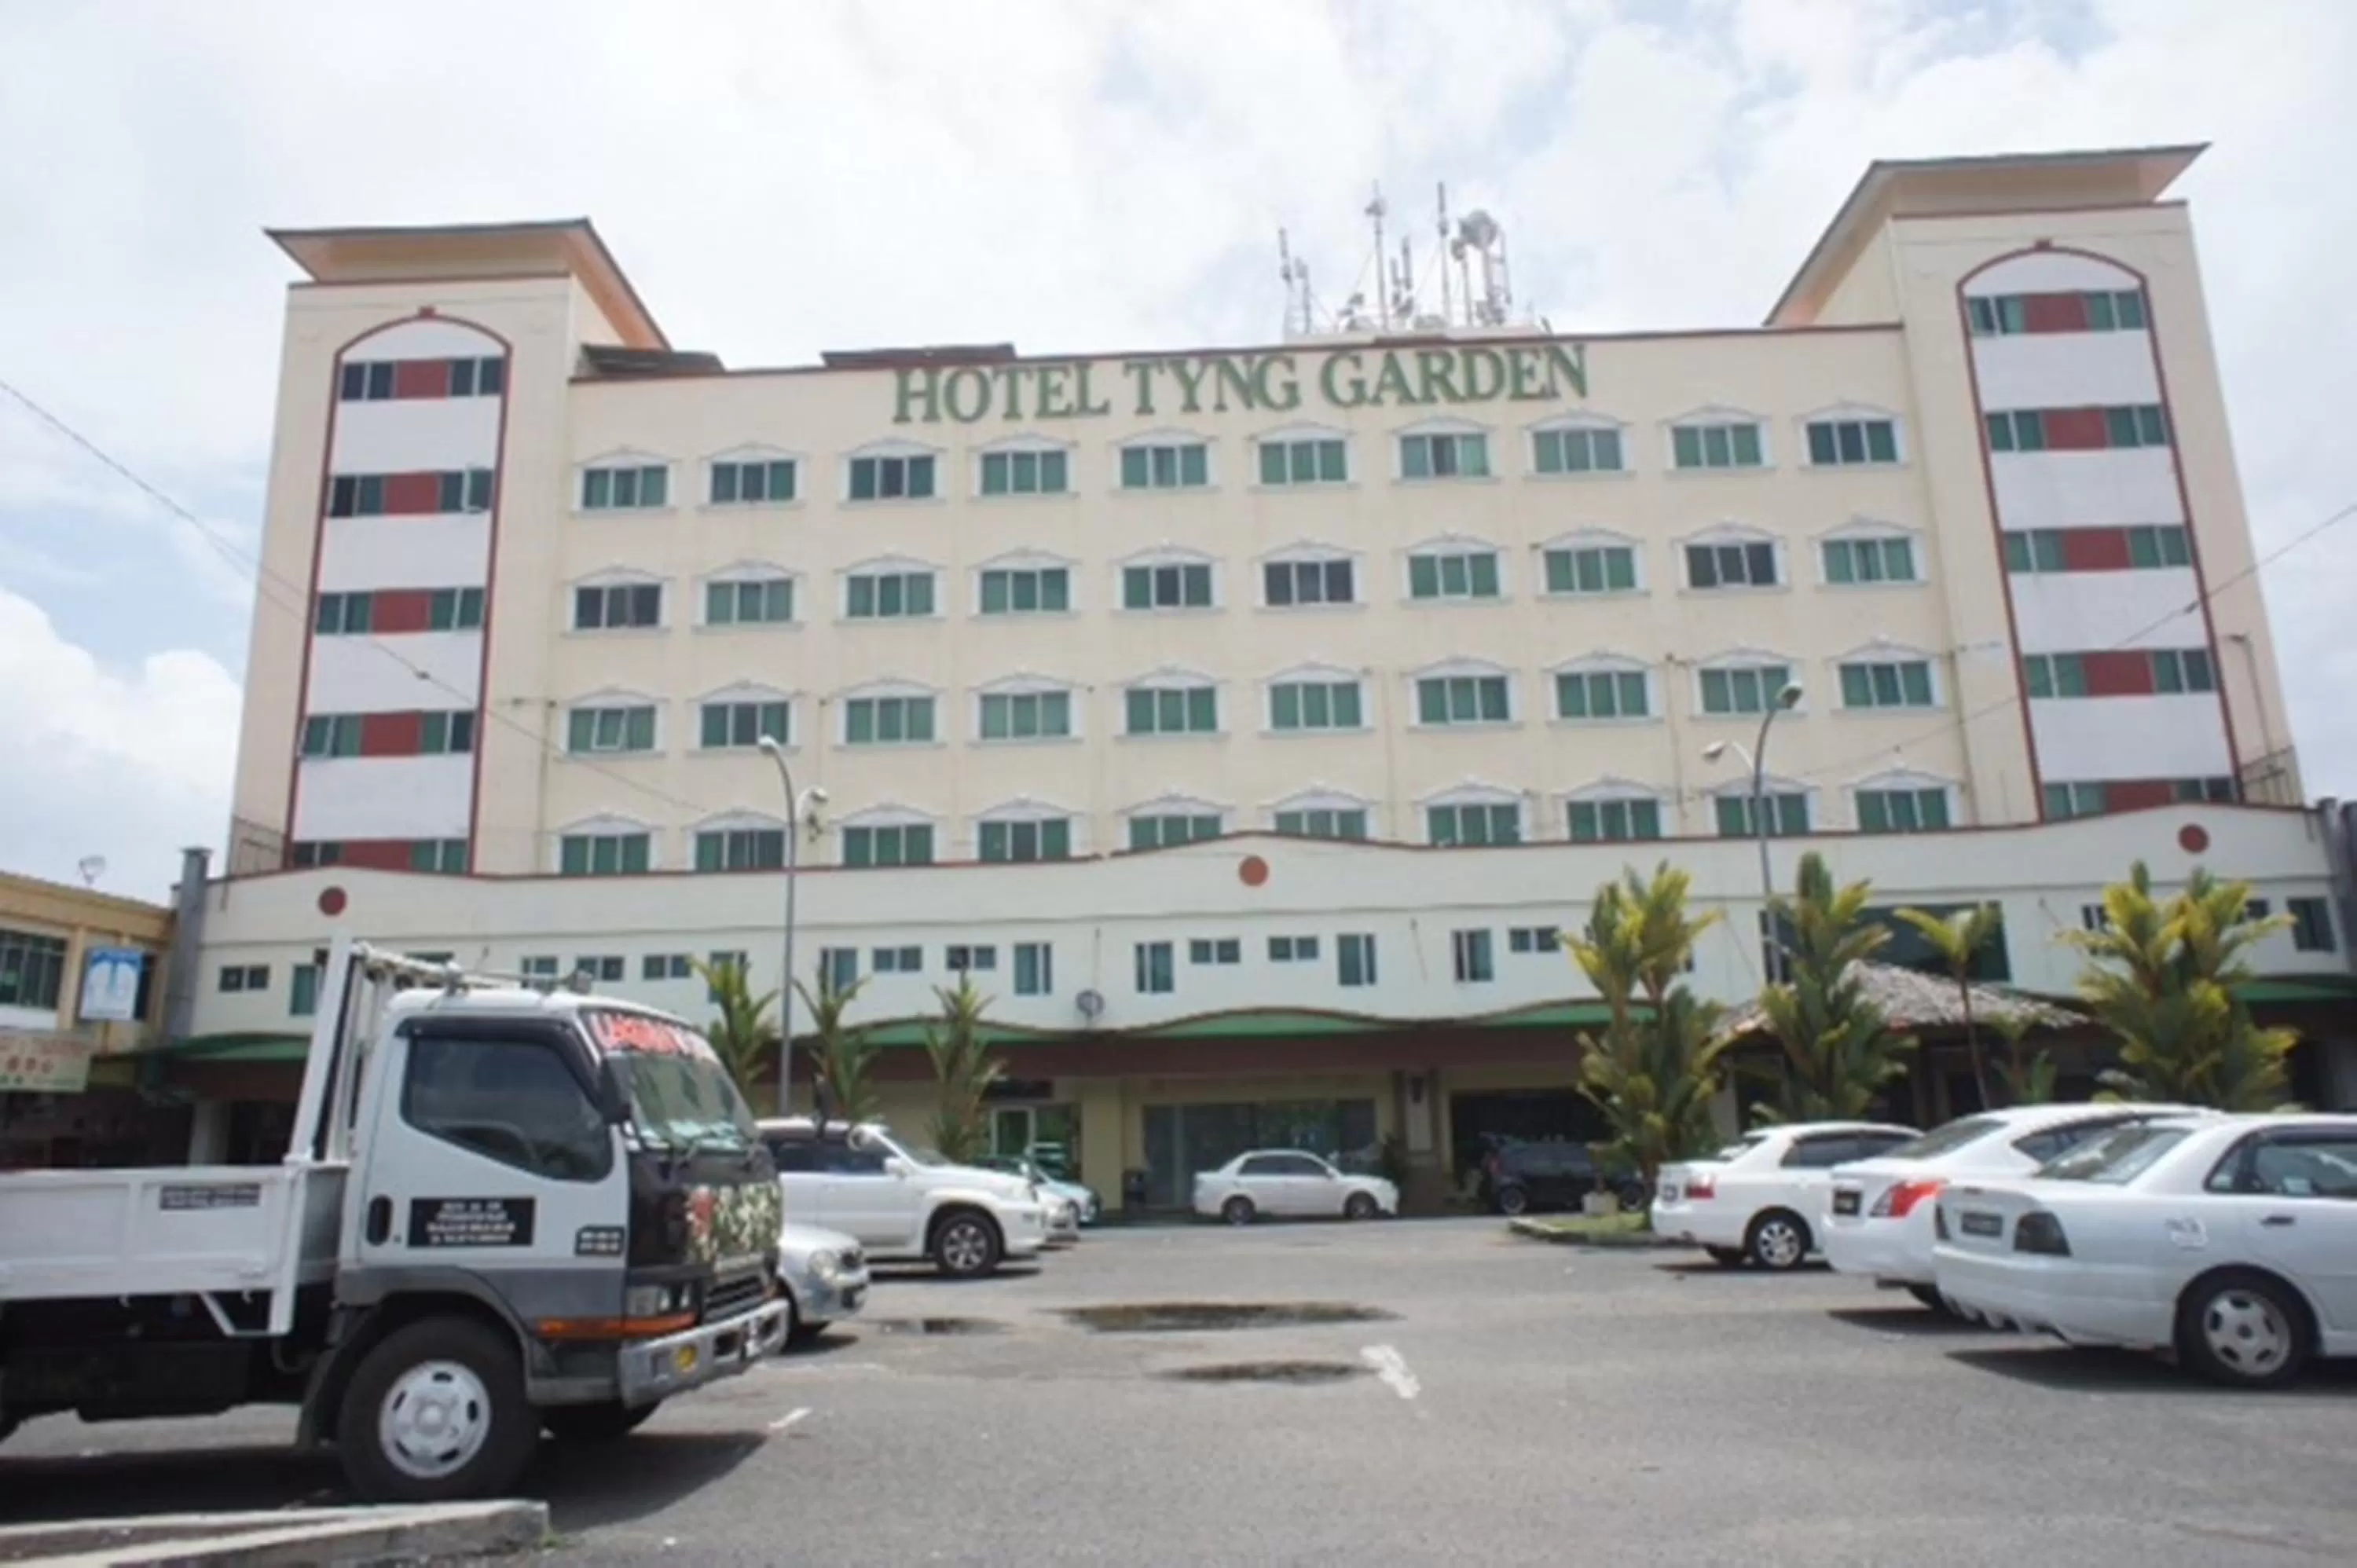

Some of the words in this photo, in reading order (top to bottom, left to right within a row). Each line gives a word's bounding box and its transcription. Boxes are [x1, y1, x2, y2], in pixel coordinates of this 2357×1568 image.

[891, 362, 1110, 424] HOTEL
[1123, 354, 1301, 416] TYNG
[1320, 343, 1587, 408] GARDEN
